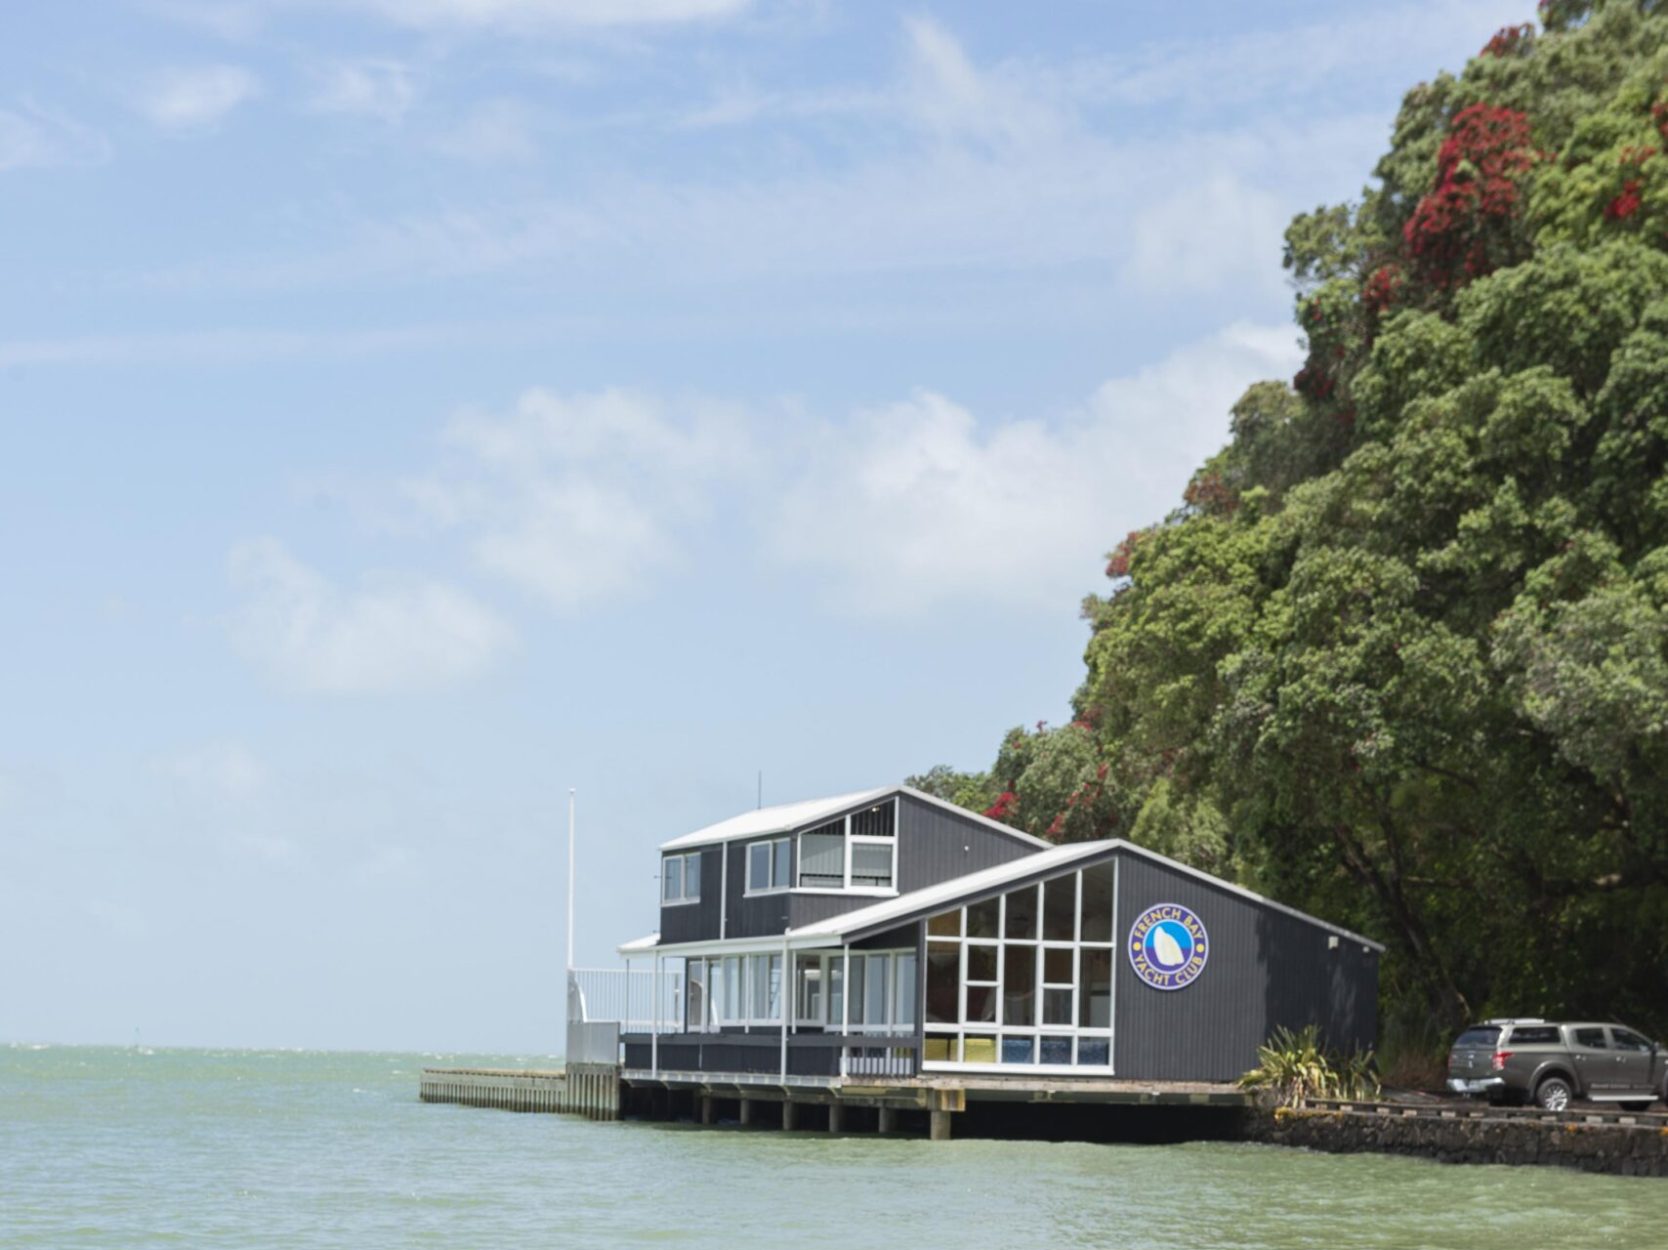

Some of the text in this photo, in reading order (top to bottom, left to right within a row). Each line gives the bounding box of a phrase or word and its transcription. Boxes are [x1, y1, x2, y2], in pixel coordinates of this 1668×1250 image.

[1134, 907, 1204, 939] FRENCH BAY
[1134, 954, 1203, 986] YACHT CLUB
